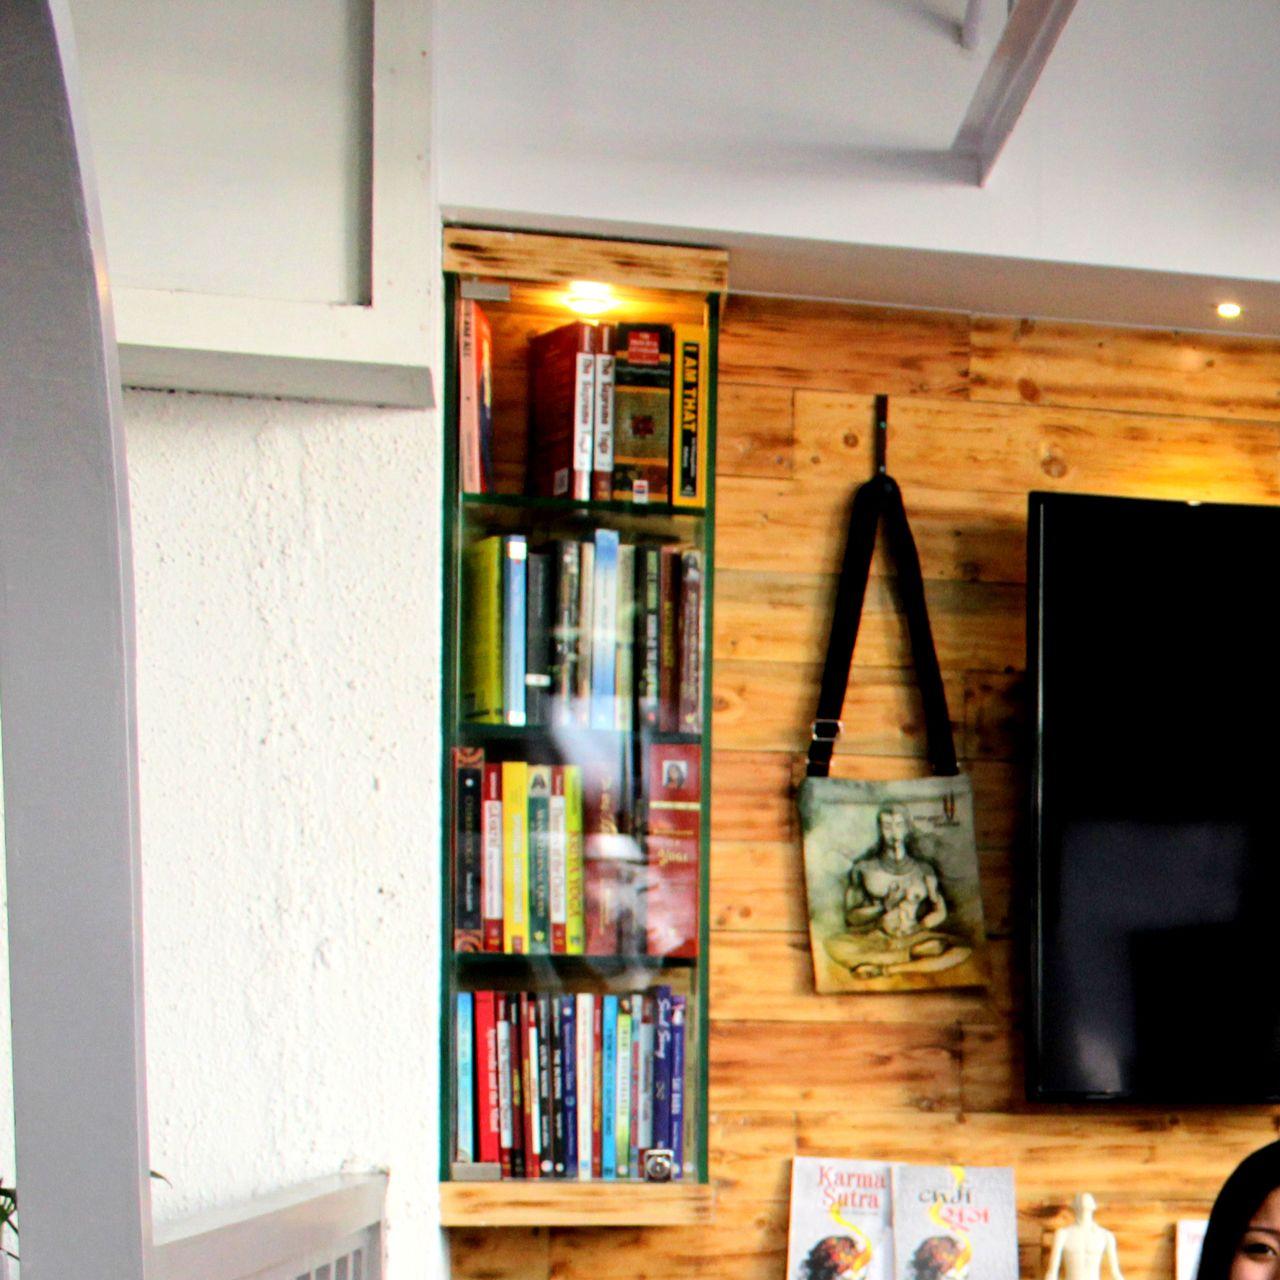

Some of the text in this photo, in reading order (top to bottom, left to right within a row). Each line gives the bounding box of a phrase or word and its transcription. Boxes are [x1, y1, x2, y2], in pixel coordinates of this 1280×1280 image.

[683, 357, 697, 383] AM
[683, 388, 697, 432] THAT
[818, 1165, 887, 1189] Karma
[823, 1187, 879, 1208] Sutra
